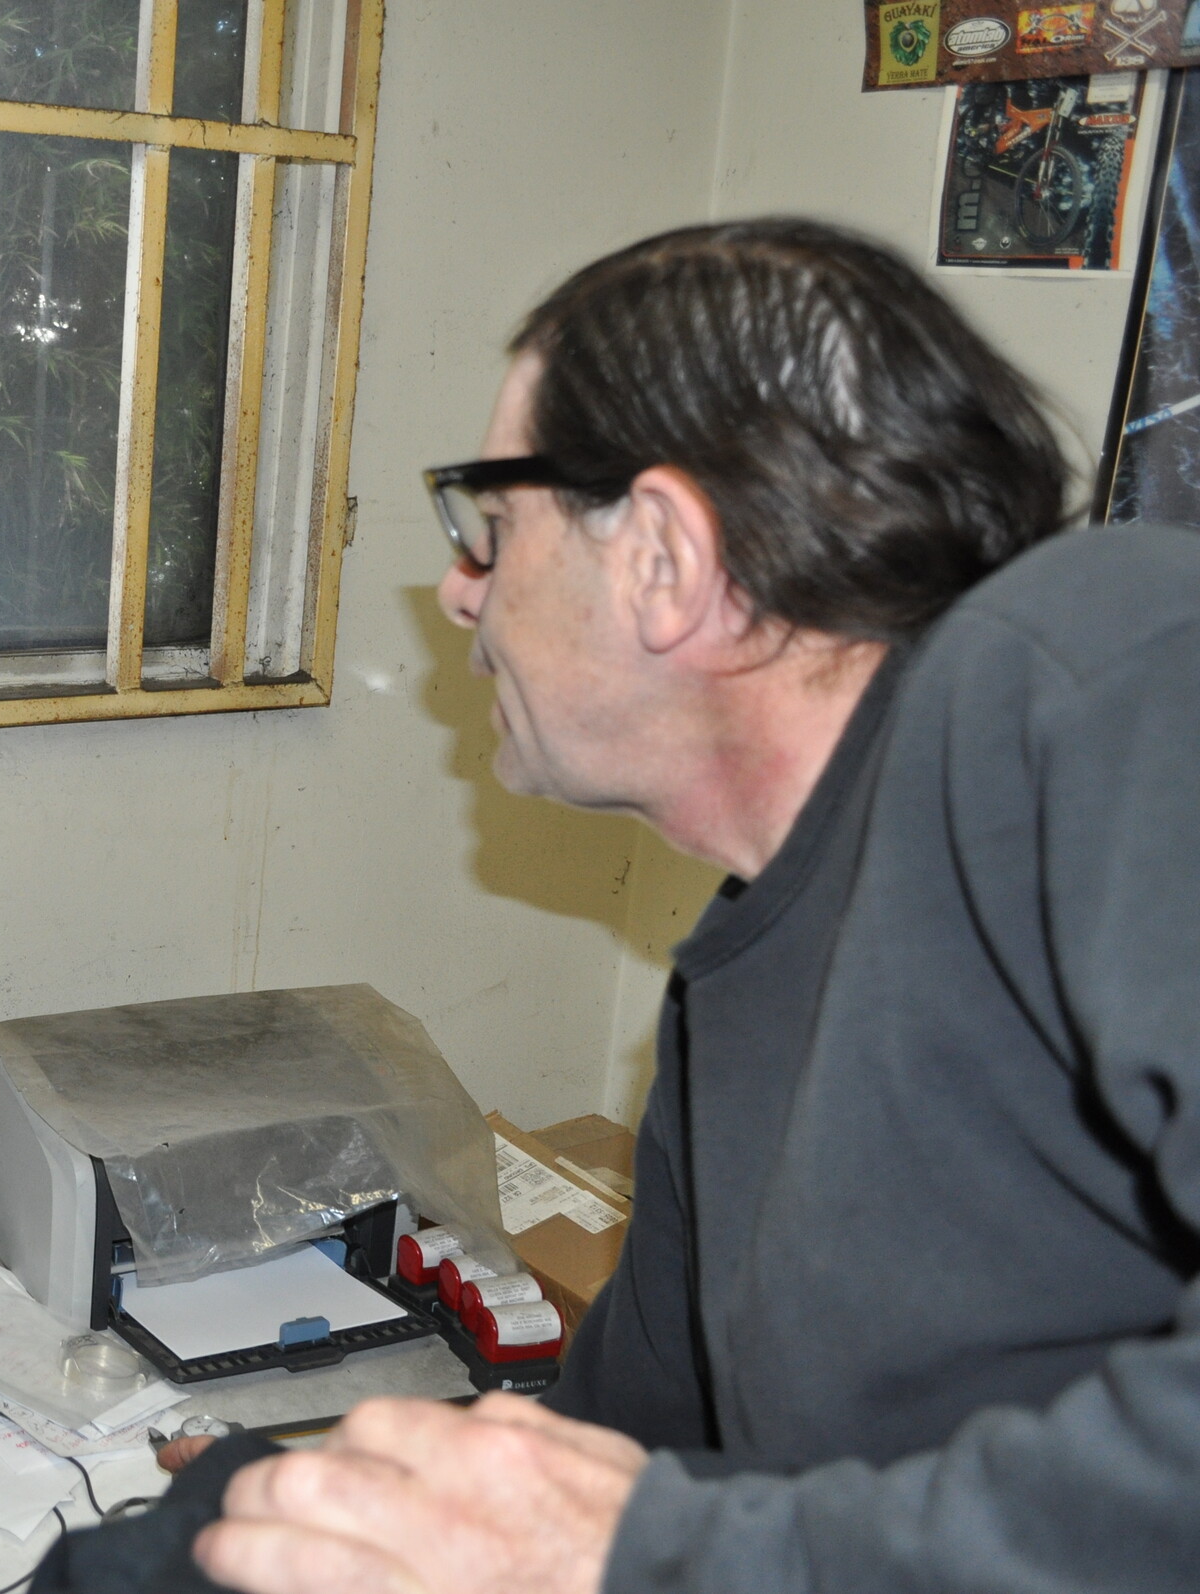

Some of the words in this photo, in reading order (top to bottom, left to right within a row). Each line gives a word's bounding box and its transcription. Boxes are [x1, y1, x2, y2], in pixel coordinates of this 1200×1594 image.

[949, 26, 1005, 45] atomlab
[886, 70, 910, 80] YERBA
[910, 68, 929, 78] MATE
[514, 1380, 547, 1389] DELUXE
